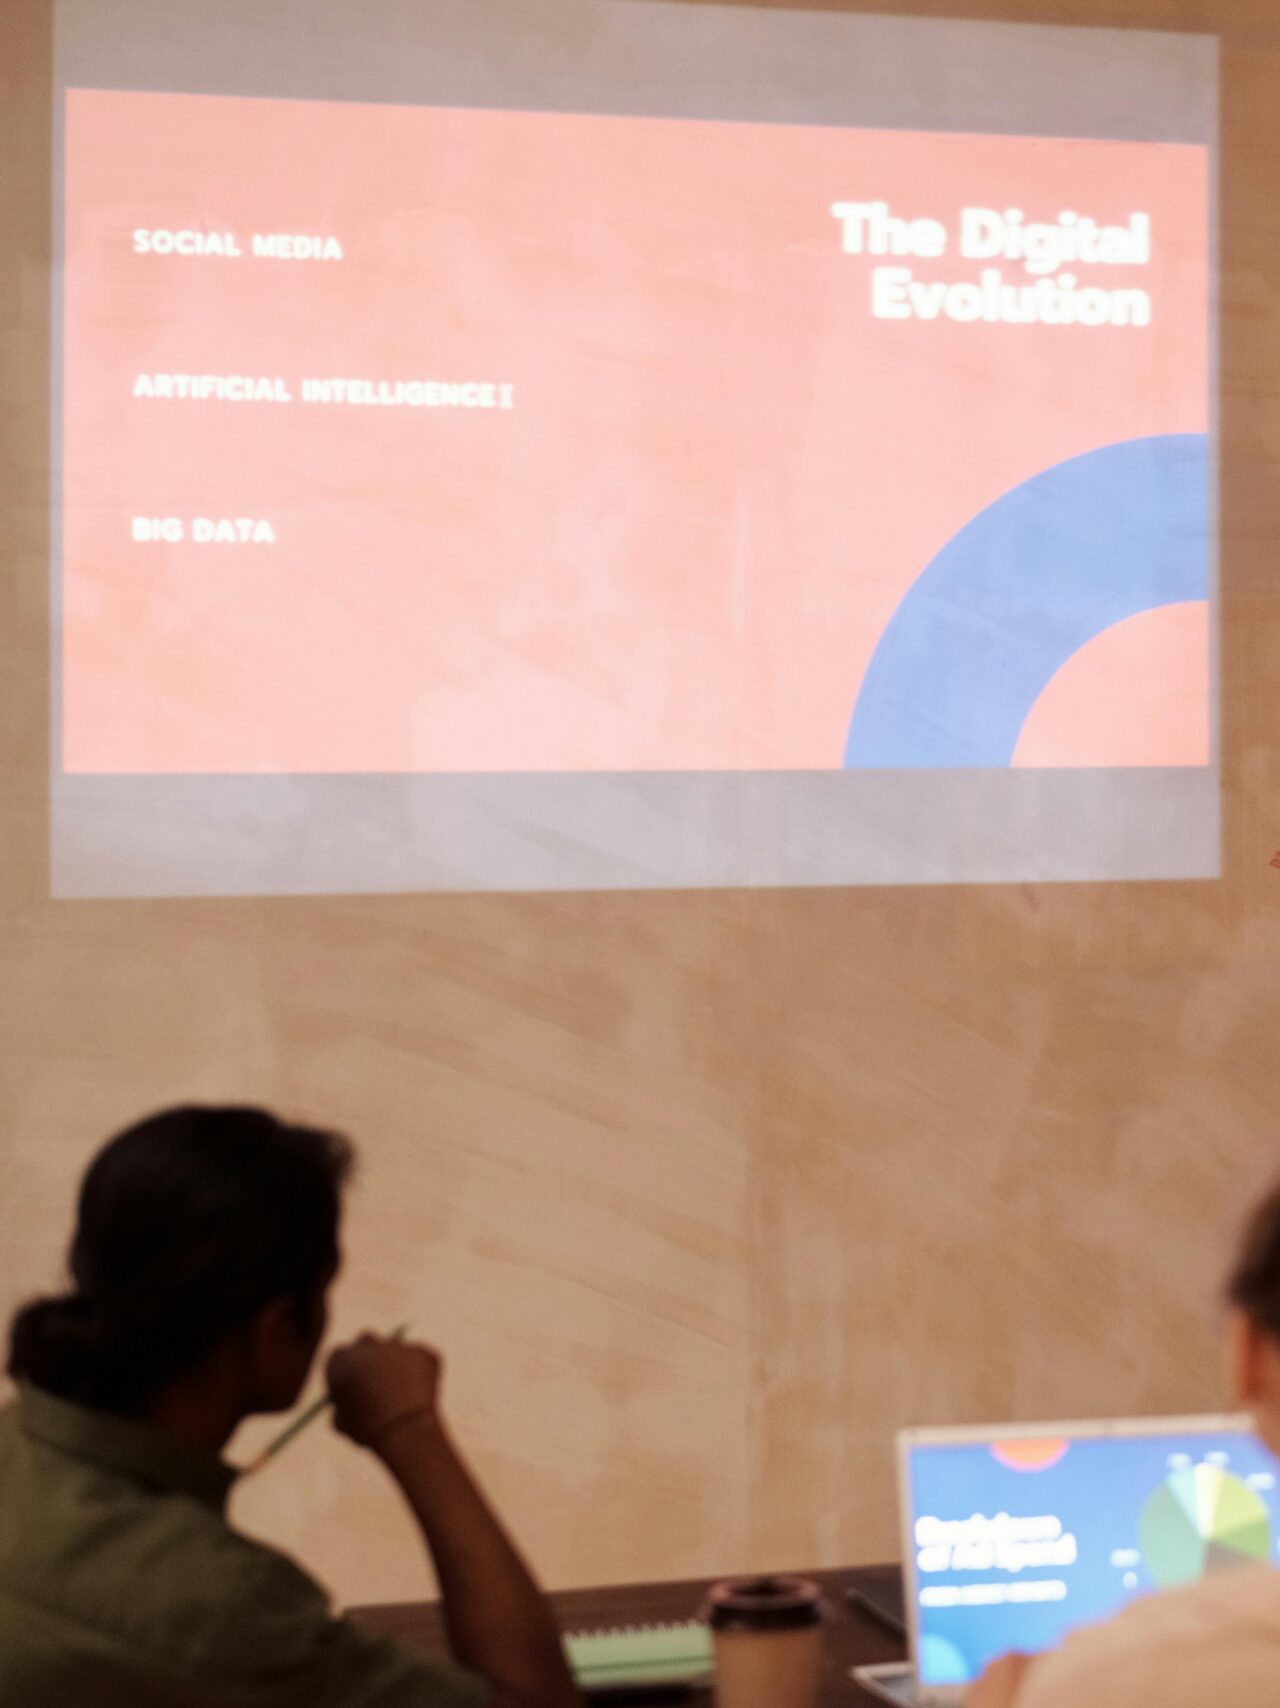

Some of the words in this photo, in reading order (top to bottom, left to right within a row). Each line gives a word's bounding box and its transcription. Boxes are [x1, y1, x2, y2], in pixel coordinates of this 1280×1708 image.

[133, 229, 241, 257] SOCIAL
[252, 234, 343, 260] MEDIA
[831, 201, 947, 257] The
[960, 207, 1149, 274] Digital
[872, 266, 1150, 326] Evolution
[133, 374, 292, 402] ARTIFICIAL
[302, 378, 496, 408] INTELLIGENCE
[132, 516, 184, 543] BIG
[192, 517, 276, 544] DATA
